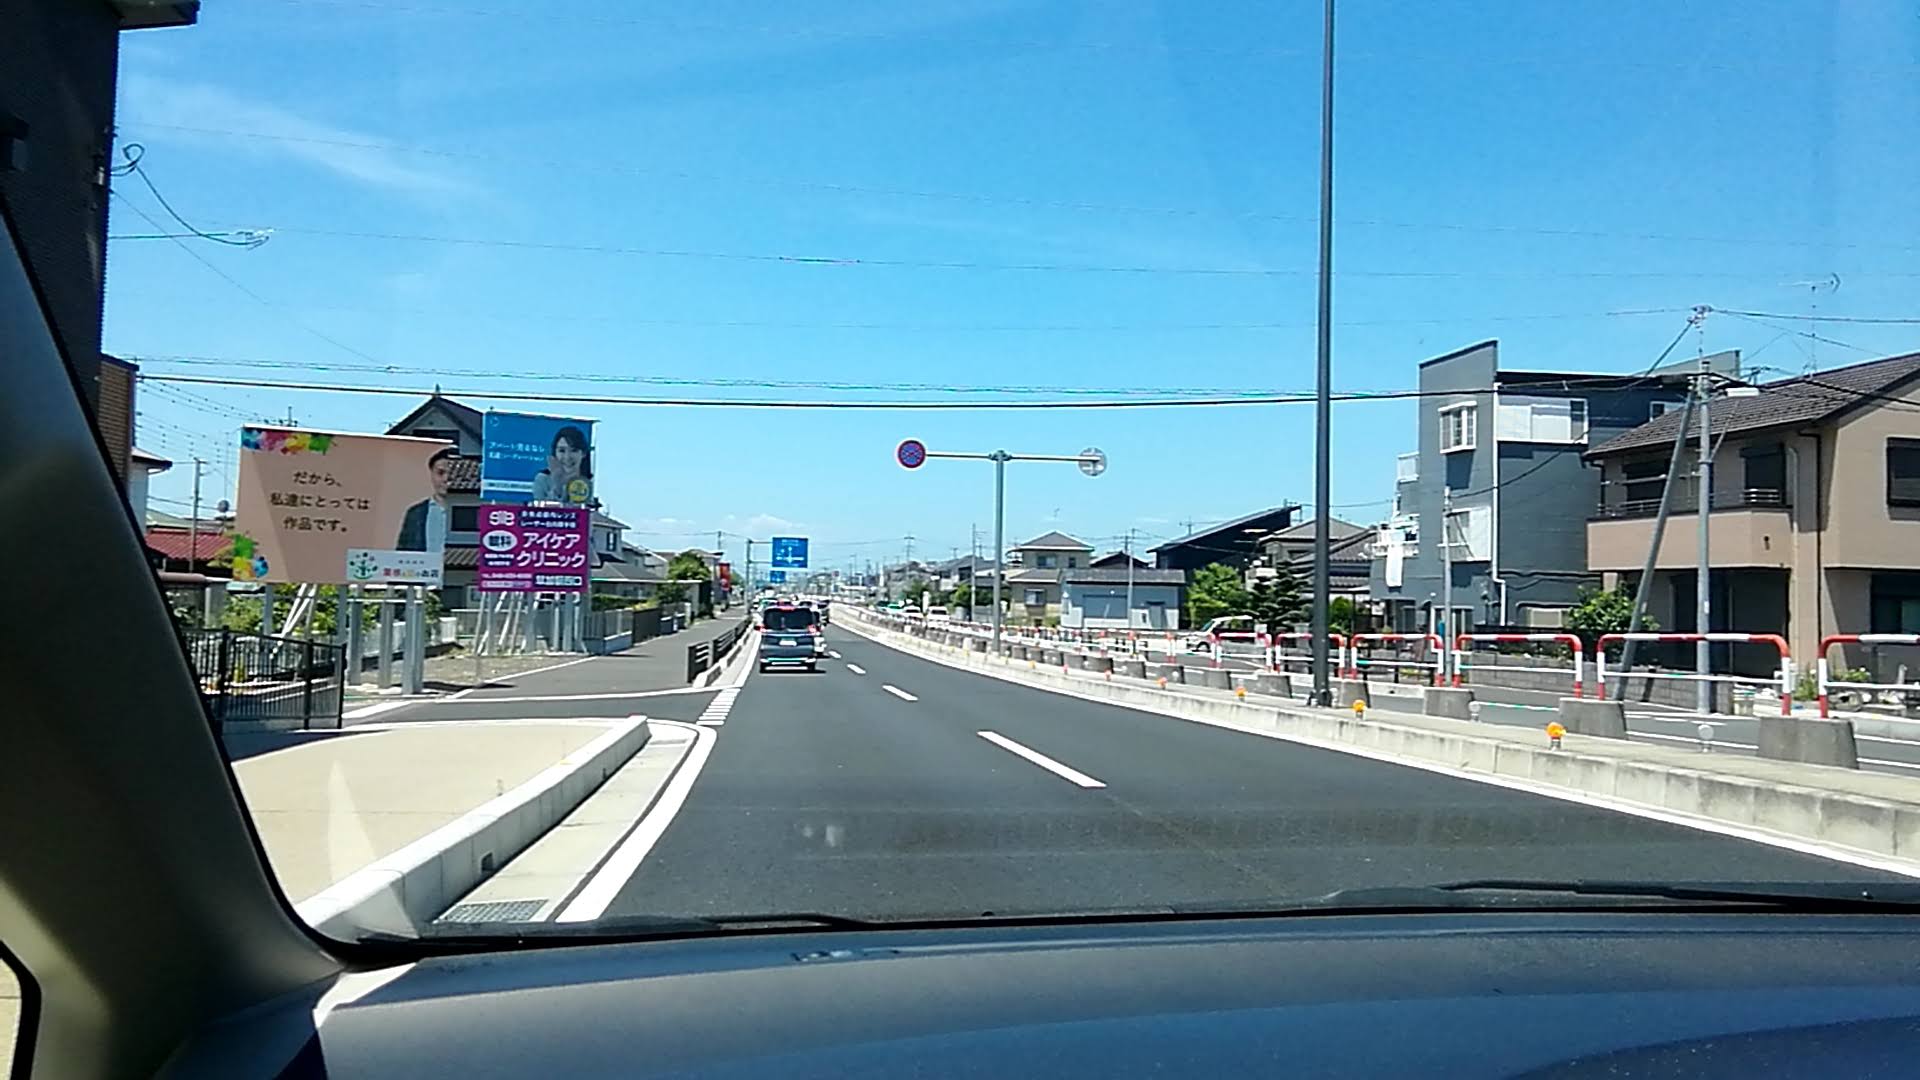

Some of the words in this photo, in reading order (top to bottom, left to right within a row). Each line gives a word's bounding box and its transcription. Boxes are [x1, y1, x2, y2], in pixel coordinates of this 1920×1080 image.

[293, 471, 342, 487] だから、
[270, 492, 370, 510] 私達にとっては
[283, 516, 347, 532] 作品です。
[523, 533, 581, 549] アイケア
[516, 550, 586, 568] クリニック
